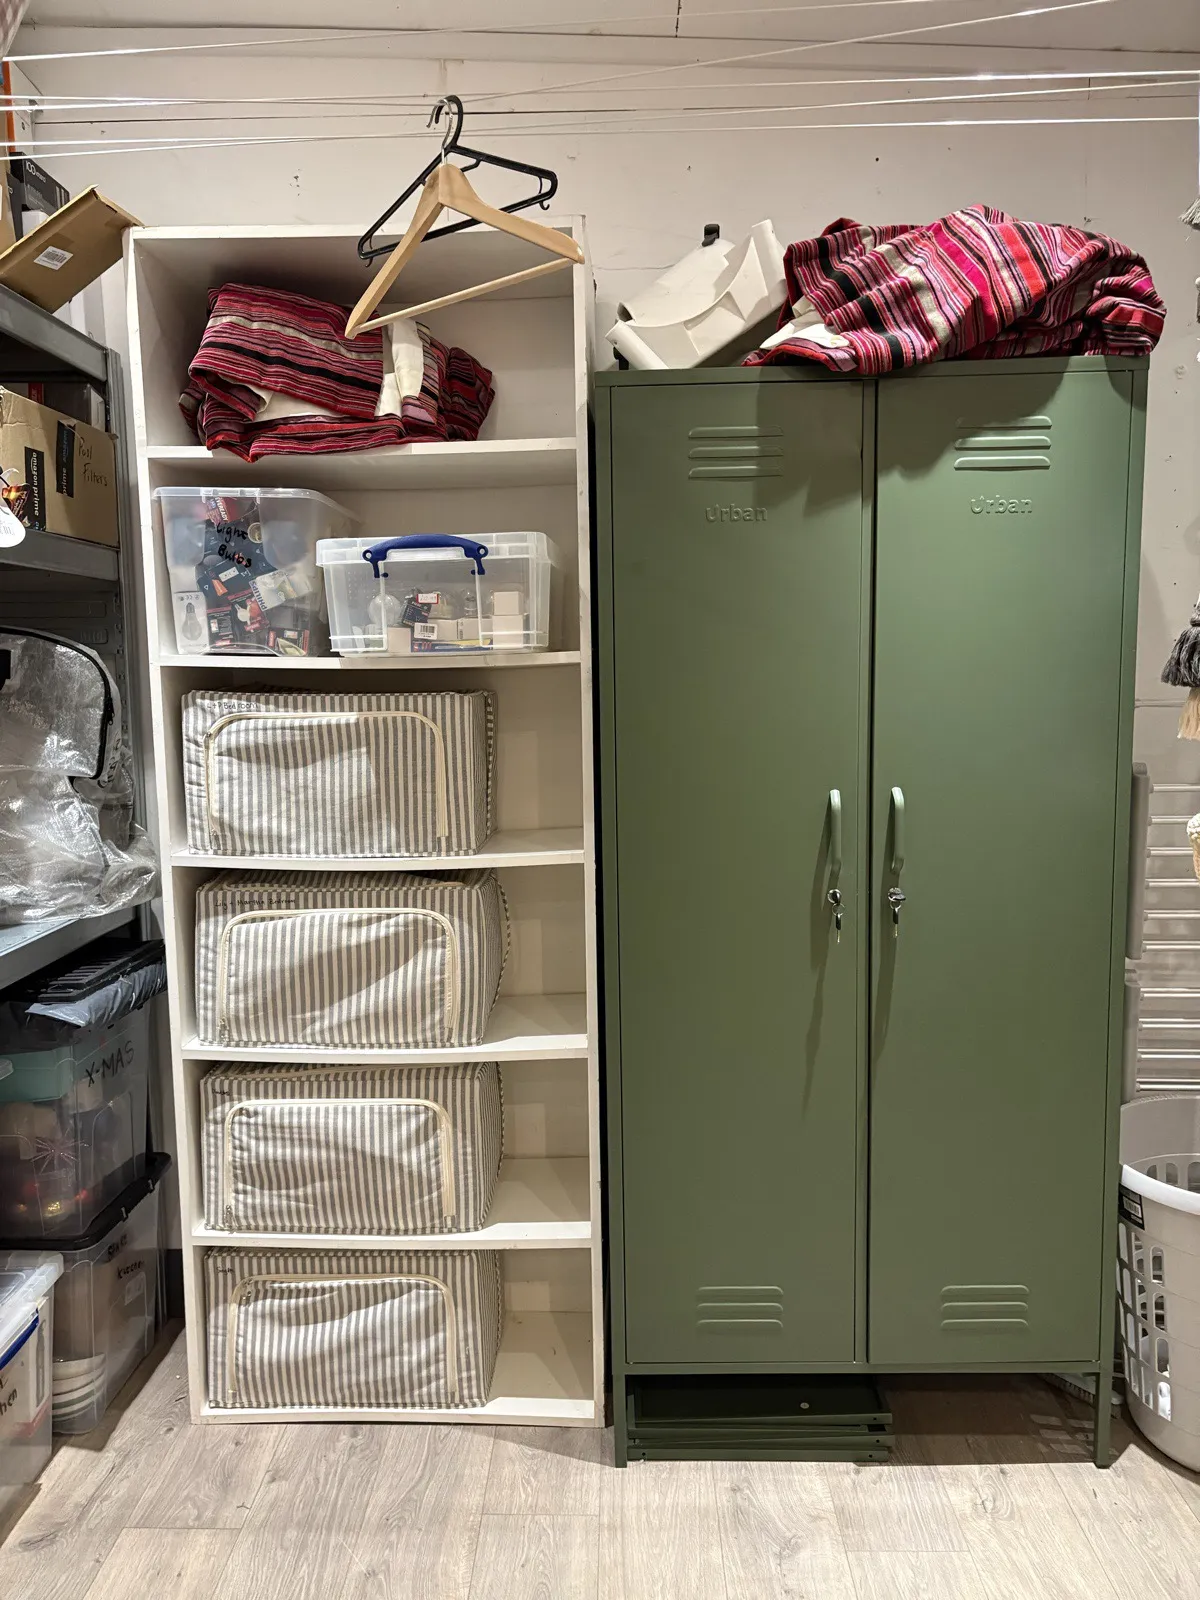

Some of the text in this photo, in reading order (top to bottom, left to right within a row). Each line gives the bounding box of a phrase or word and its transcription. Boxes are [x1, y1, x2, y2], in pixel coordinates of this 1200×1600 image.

[30, 452, 38, 486] amazon
[82, 462, 108, 487] Filters
[32, 486, 40, 516] prime
[217, 543, 252, 568] Bulbs
[251, 580, 268, 611] PHILIPS
[85, 1040, 135, 1088] X-MAS
